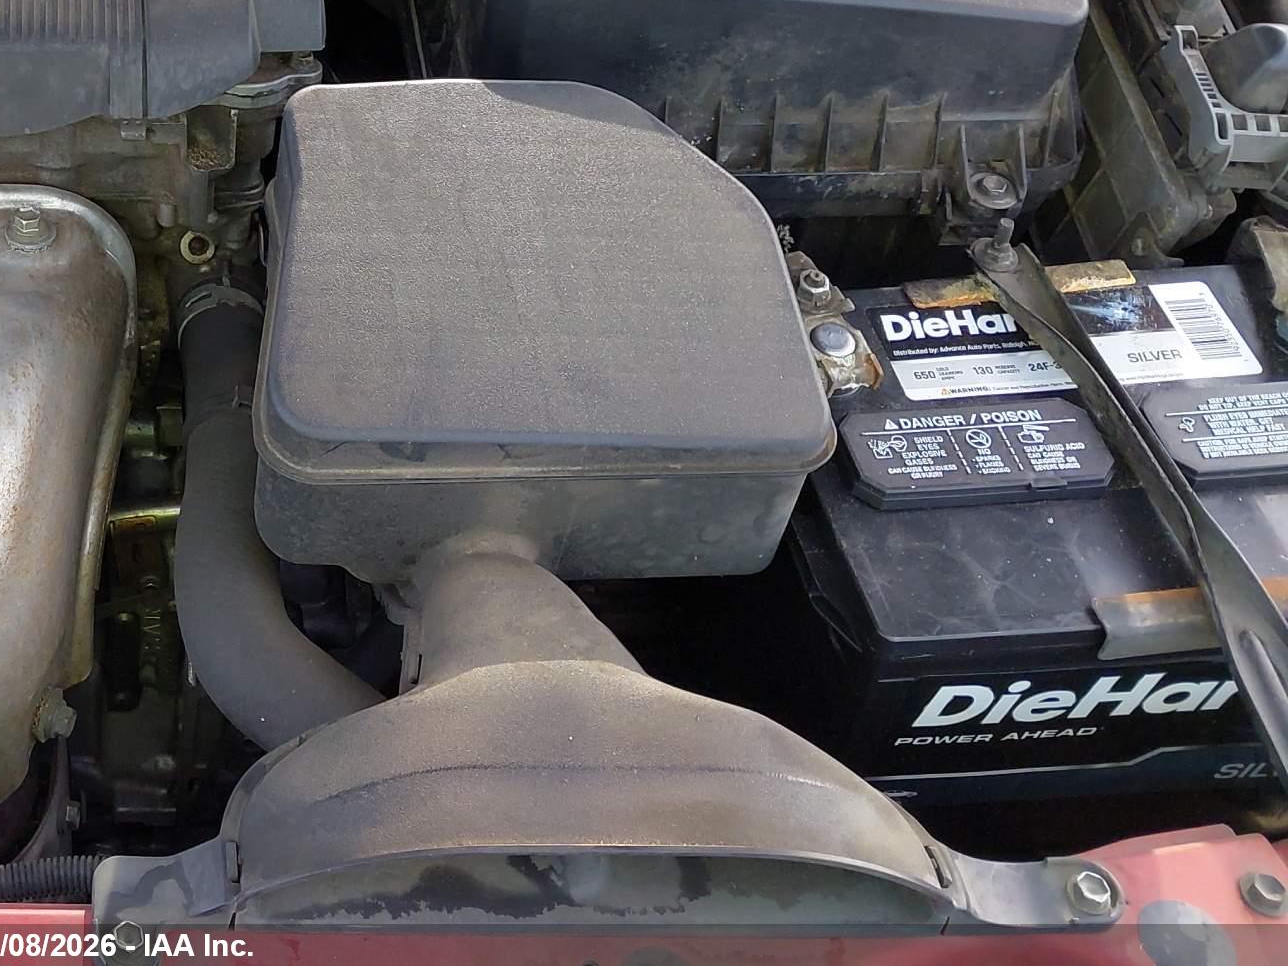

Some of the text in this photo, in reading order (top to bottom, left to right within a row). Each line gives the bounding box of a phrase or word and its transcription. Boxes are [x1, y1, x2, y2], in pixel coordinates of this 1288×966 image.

[880, 309, 1018, 341] DieHar
[893, 348, 928, 357] Distributed
[928, 347, 939, 355] by:
[940, 345, 967, 353] Advance
[1128, 349, 1183, 363] SILVER
[913, 370, 936, 380] 650
[972, 366, 994, 376] 130
[949, 386, 992, 395] WARNING:
[1248, 408, 1288, 418] IMMEDIATE
[899, 415, 966, 430] DANGER
[982, 409, 1043, 423] POISON
[1266, 423, 1286, 432] FAST
[913, 435, 944, 444] SHIELD
[917, 443, 940, 451] EYES
[1024, 441, 1086, 452] SULFURIC ACID
[902, 450, 948, 459] EXPLOSIVE
[905, 458, 934, 466] GASES
[911, 672, 1239, 727] DieHar
[894, 727, 1098, 746] POWER AHEAD
[1213, 762, 1268, 779] SIL
